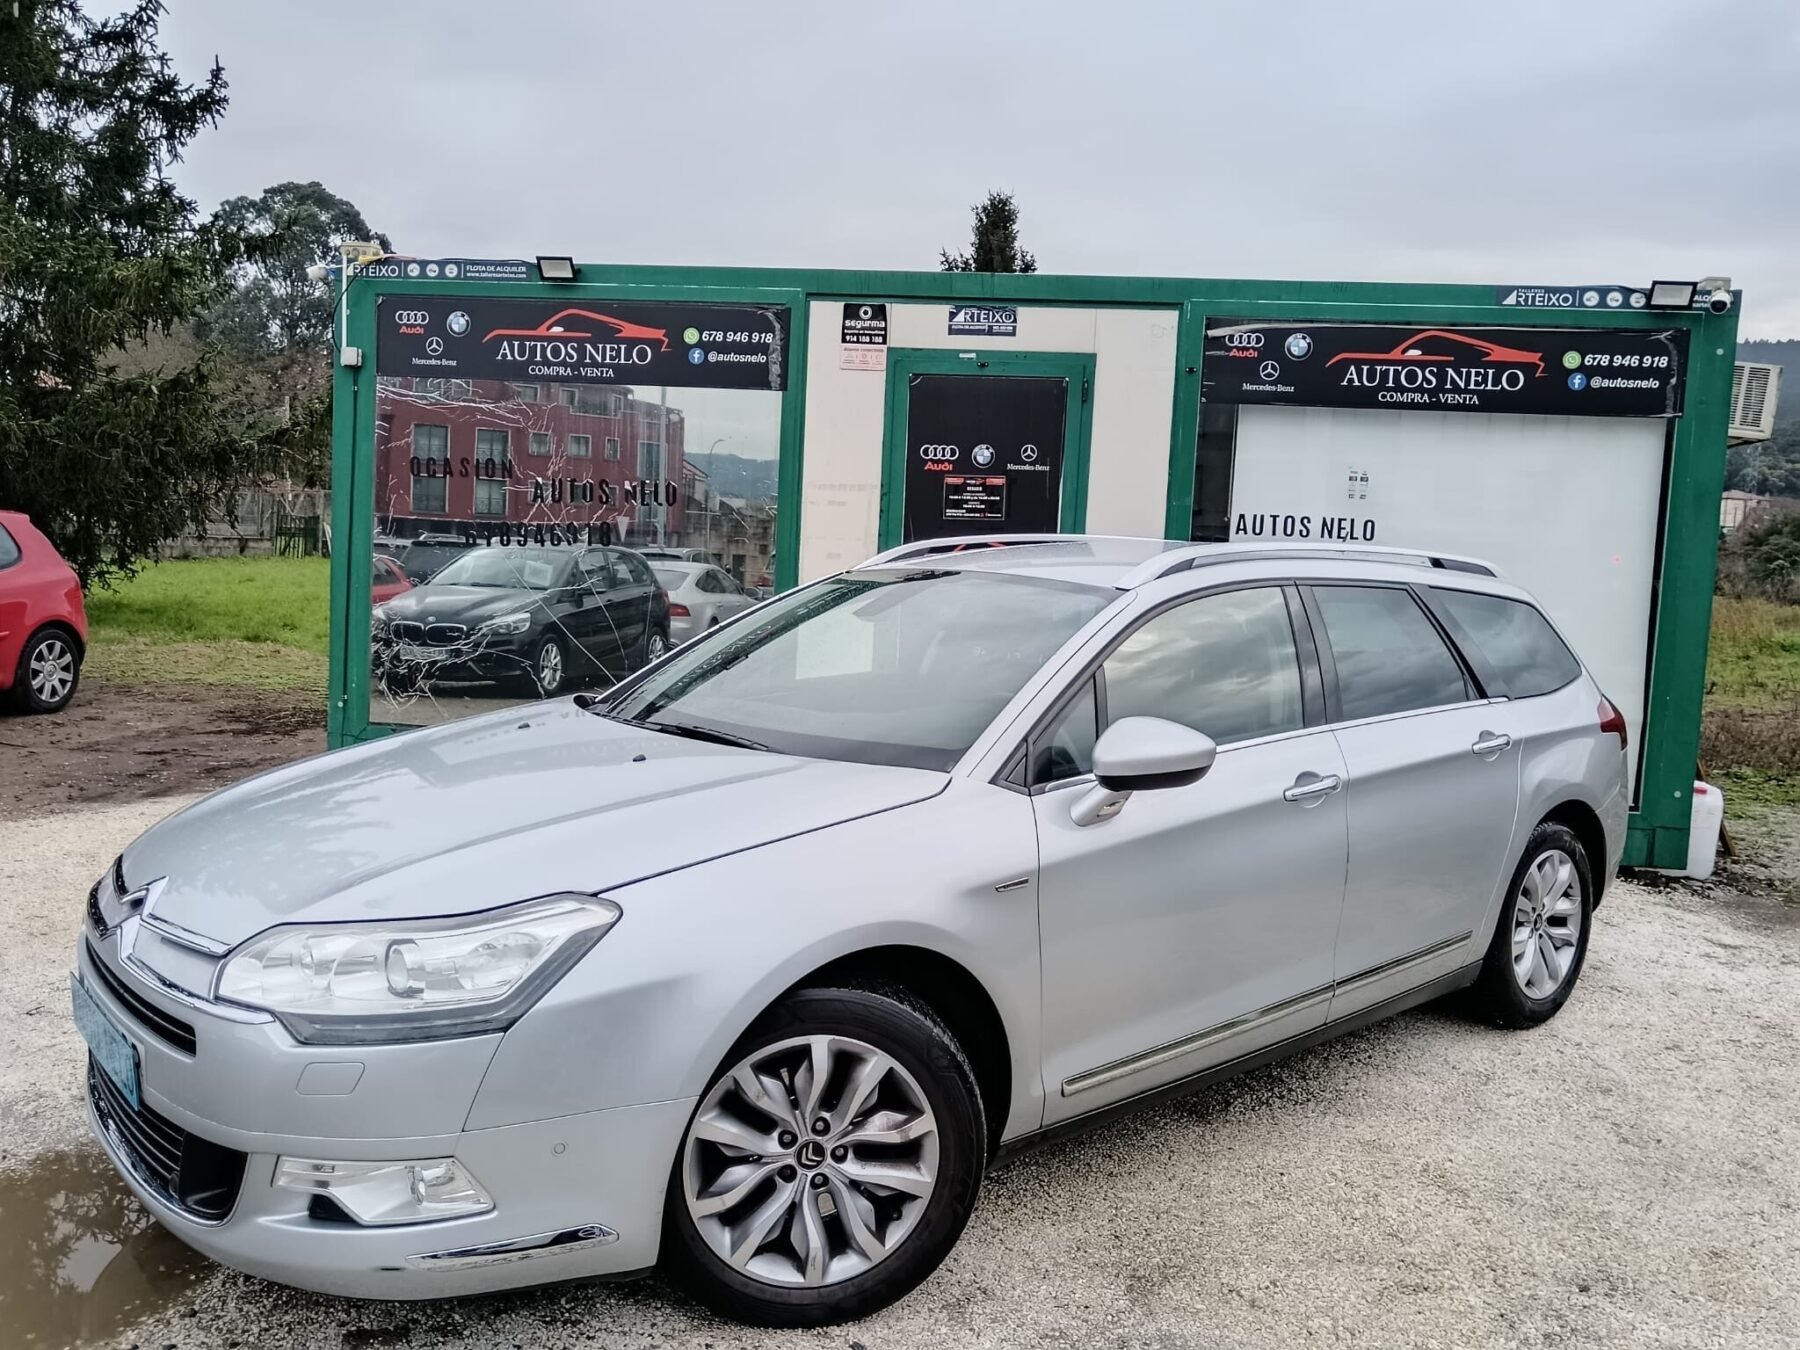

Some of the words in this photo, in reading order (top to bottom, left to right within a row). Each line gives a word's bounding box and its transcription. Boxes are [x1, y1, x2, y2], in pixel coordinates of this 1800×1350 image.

[399, 326, 425, 335] Audi
[702, 331, 724, 342] 678
[726, 331, 749, 343] 946
[752, 332, 774, 344] 918
[496, 340, 578, 363] AUTOS
[584, 342, 652, 365] NELO
[707, 351, 767, 363] @autosnelo
[1229, 348, 1258, 358] Audi
[411, 357, 458, 367] Mercedes-Benz
[1584, 354, 1610, 367] 678
[1613, 355, 1640, 367] 946
[1642, 356, 1669, 368] 918
[528, 365, 572, 377] COMPRA
[580, 367, 615, 378] VENTA
[1340, 364, 1437, 389] AUTOS
[1444, 367, 1525, 391] NELO
[1242, 382, 1295, 392] Mercedes-Benz
[1590, 376, 1660, 389] @autosnelo
[1378, 391, 1430, 404] COMPRA
[1439, 393, 1479, 405] VENTA
[410, 456, 513, 480] OCASION
[924, 461, 953, 471] Audi
[1006, 463, 1050, 471] Mercedes-Benz
[532, 477, 612, 506] AUTOS
[624, 479, 678, 507] NELO
[1234, 513, 1312, 538] AUTOS
[1320, 516, 1376, 542] NELO
